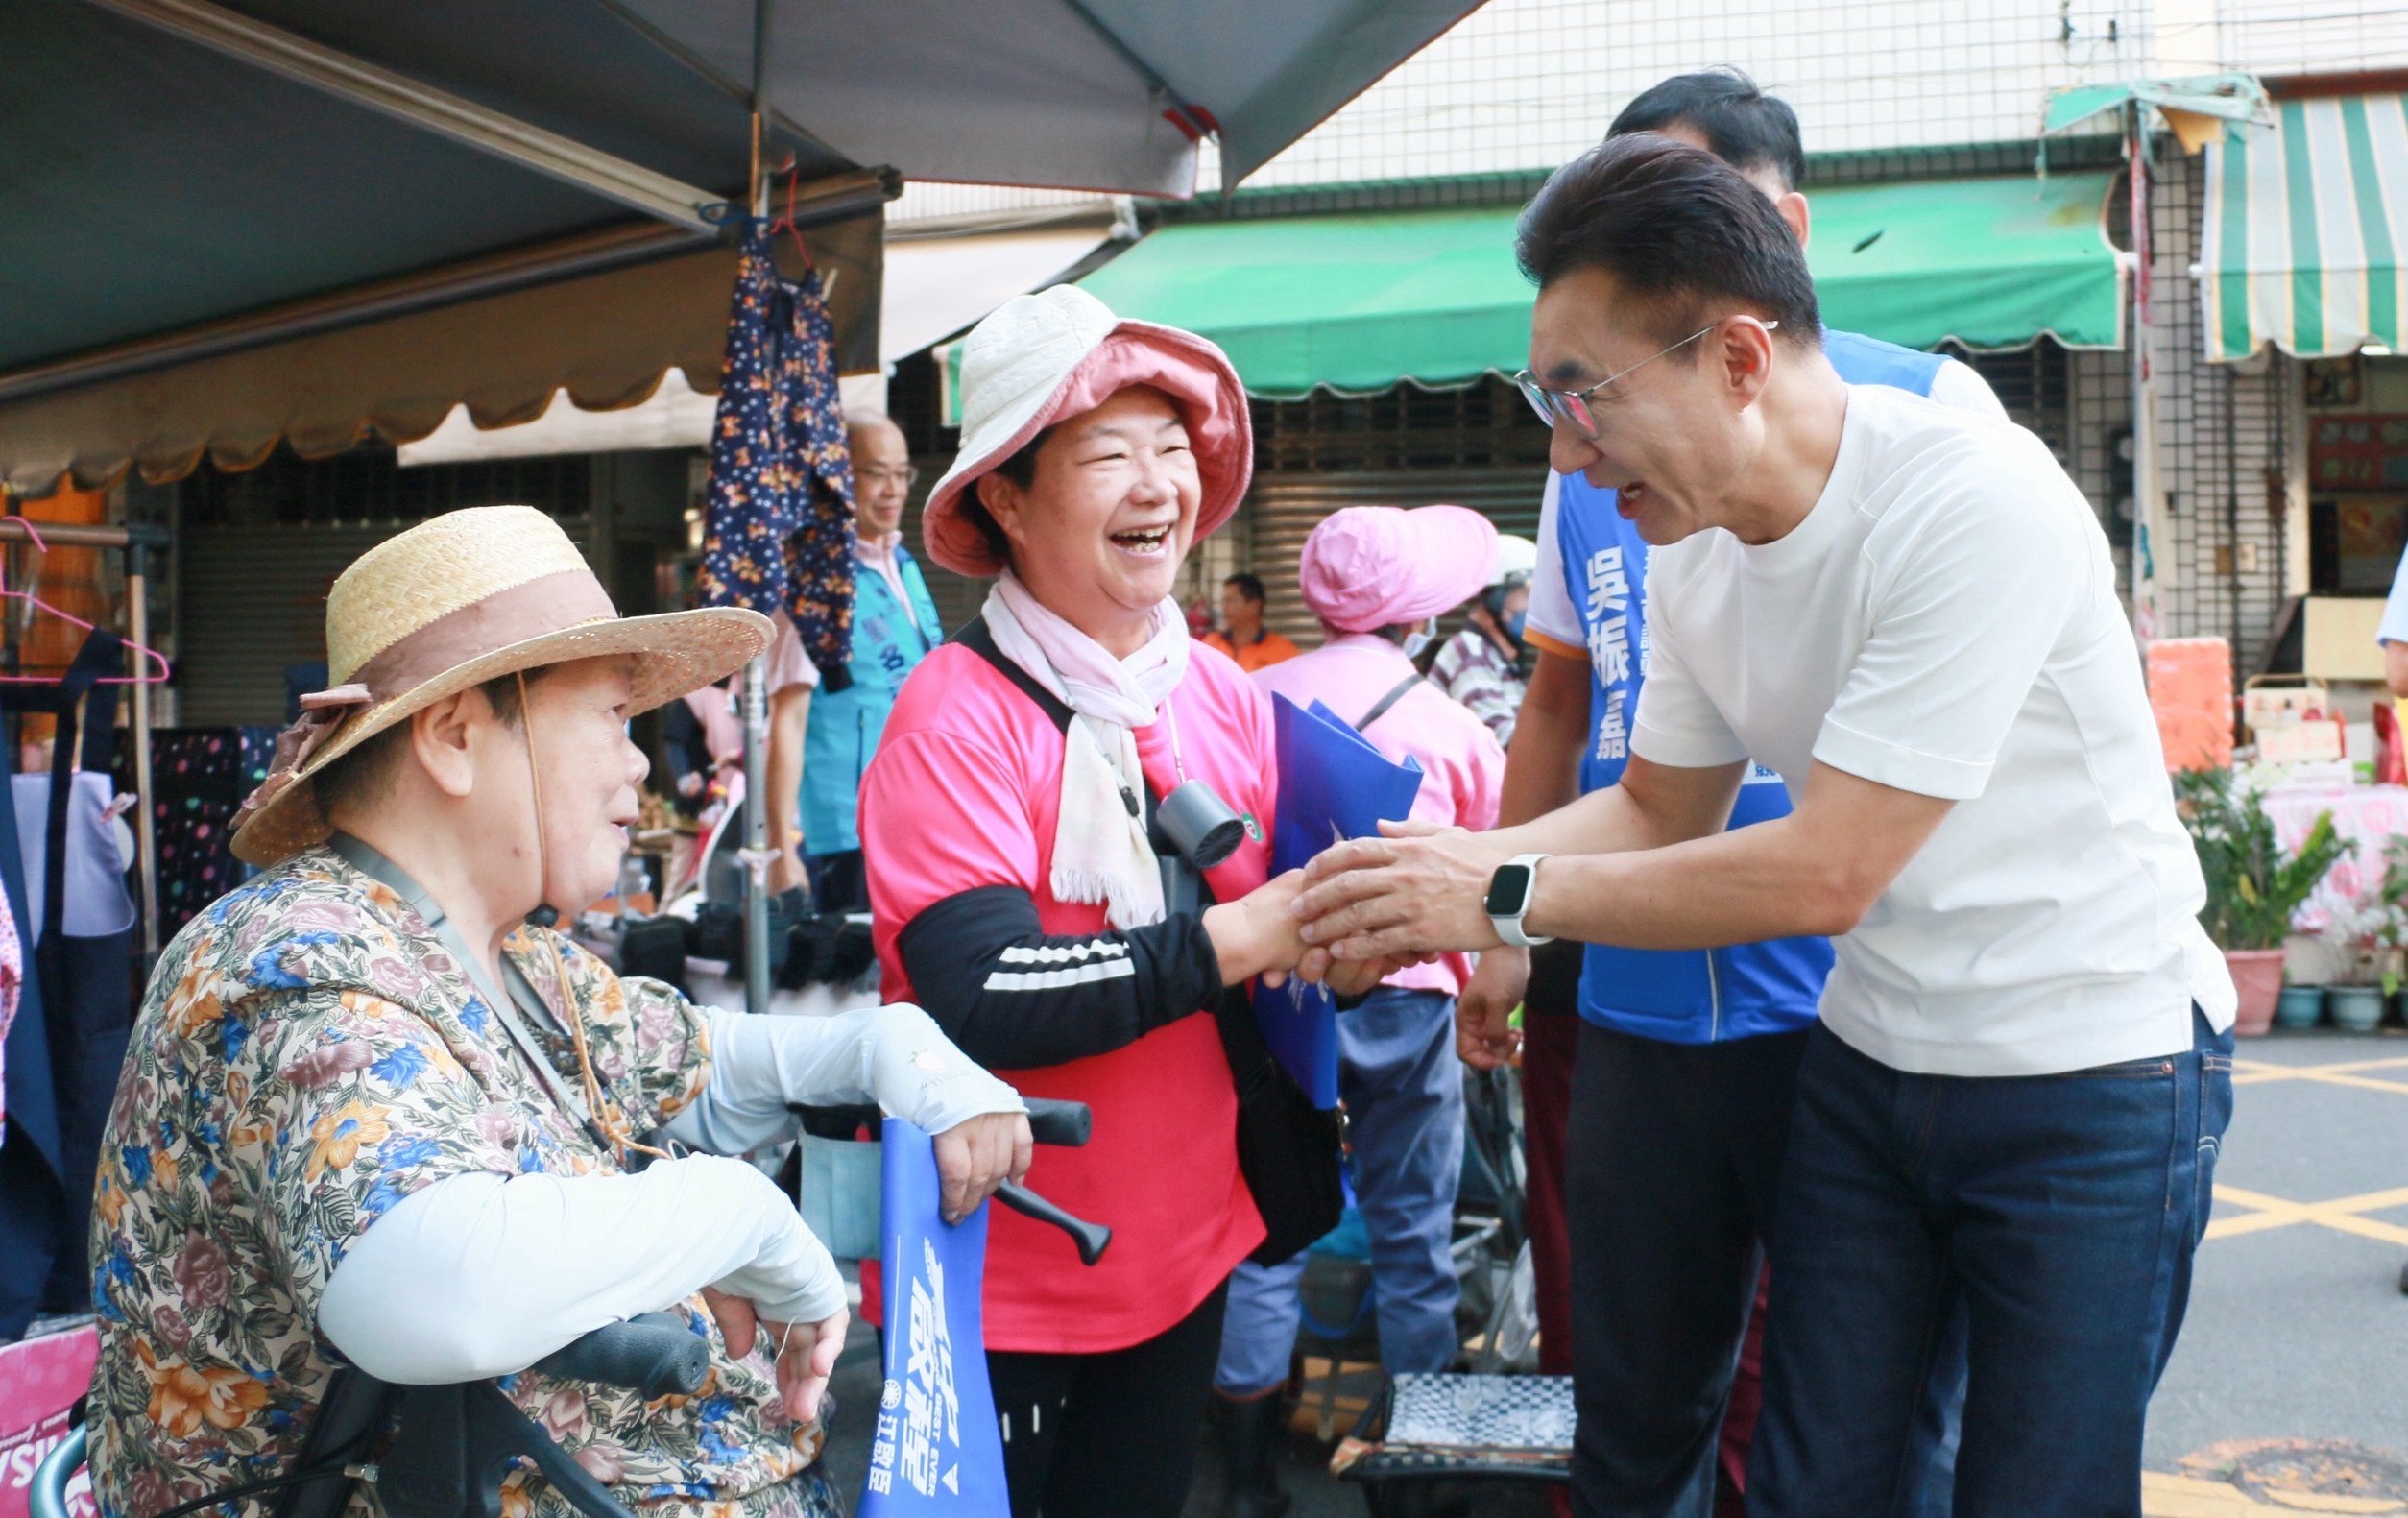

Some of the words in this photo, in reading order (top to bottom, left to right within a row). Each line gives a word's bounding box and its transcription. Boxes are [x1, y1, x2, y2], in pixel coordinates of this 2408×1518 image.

[1585, 545, 1629, 760] 吳振嘉
[901, 1275, 935, 1496] 啟程
[933, 1392, 943, 1442] BEST
[927, 1447, 939, 1497] EVER
